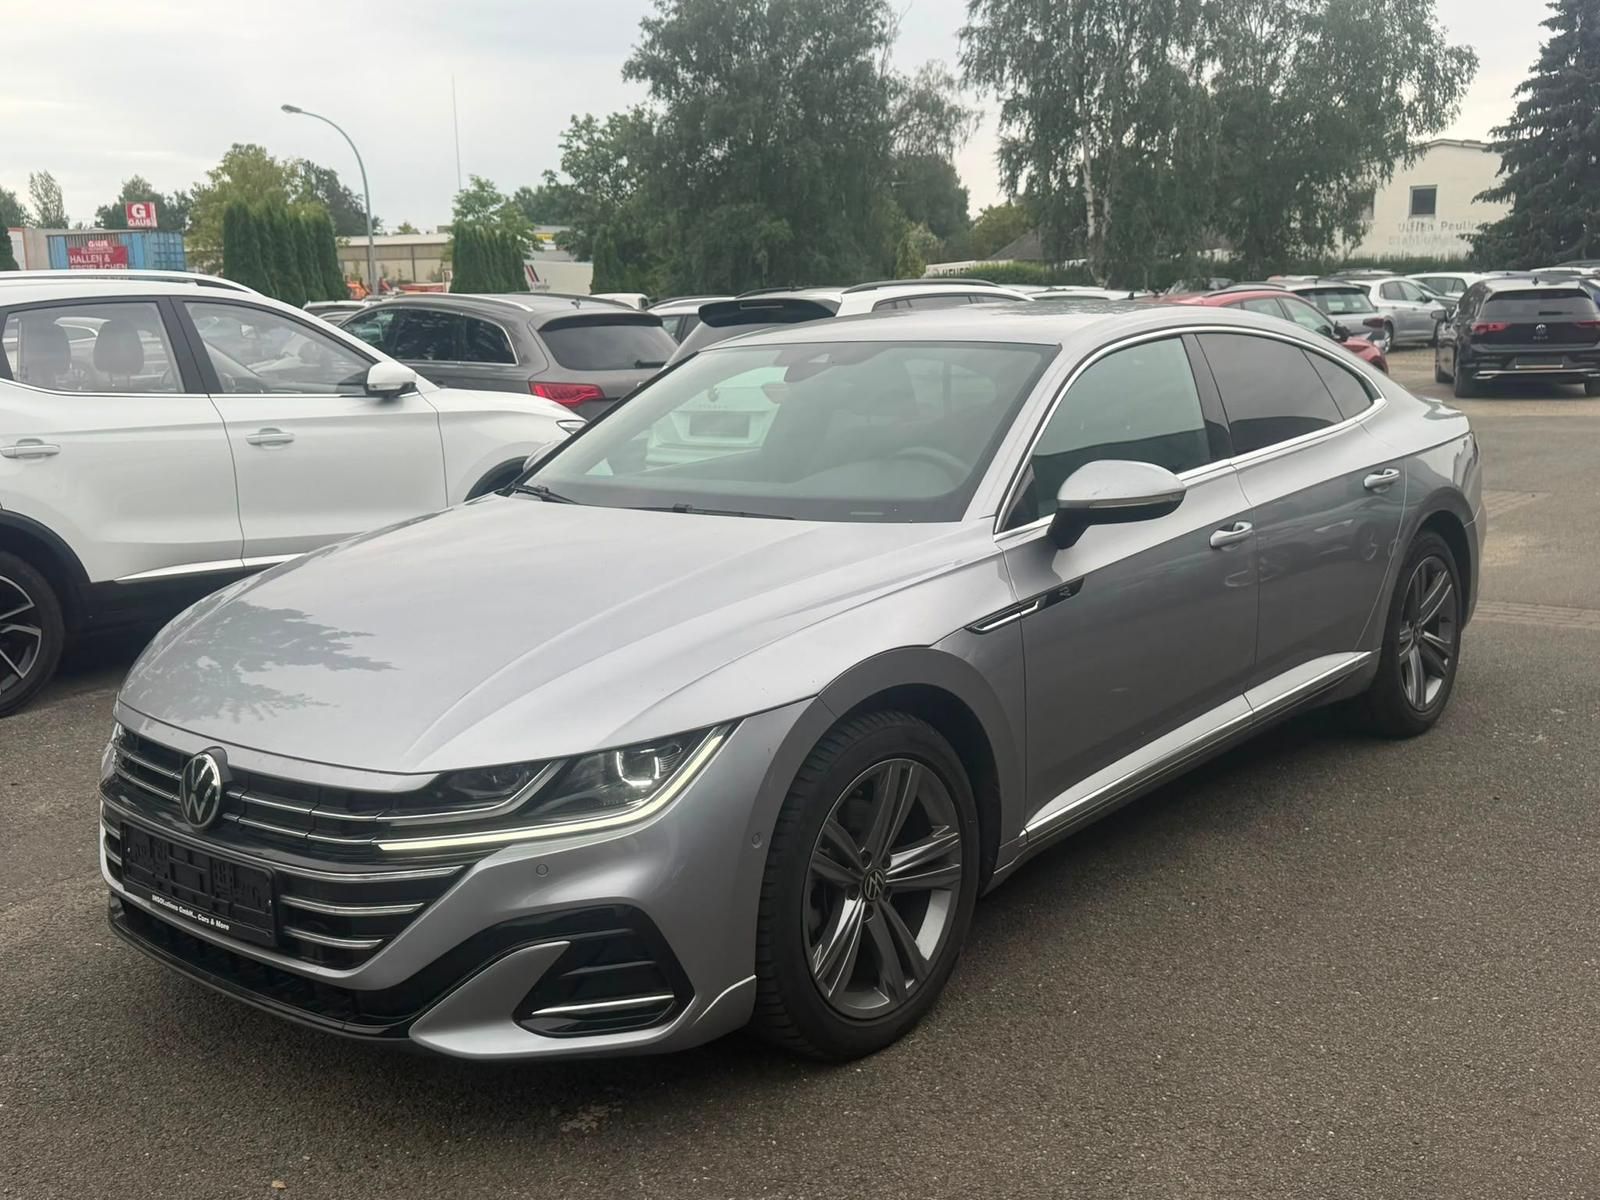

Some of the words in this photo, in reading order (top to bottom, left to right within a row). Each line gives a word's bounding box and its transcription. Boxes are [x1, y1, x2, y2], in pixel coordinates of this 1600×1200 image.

[131, 203, 147, 218] G
[70, 254, 103, 264] HALLEN
[104, 254, 111, 263] &
[197, 913, 210, 924] Cars
[215, 919, 230, 931] More
